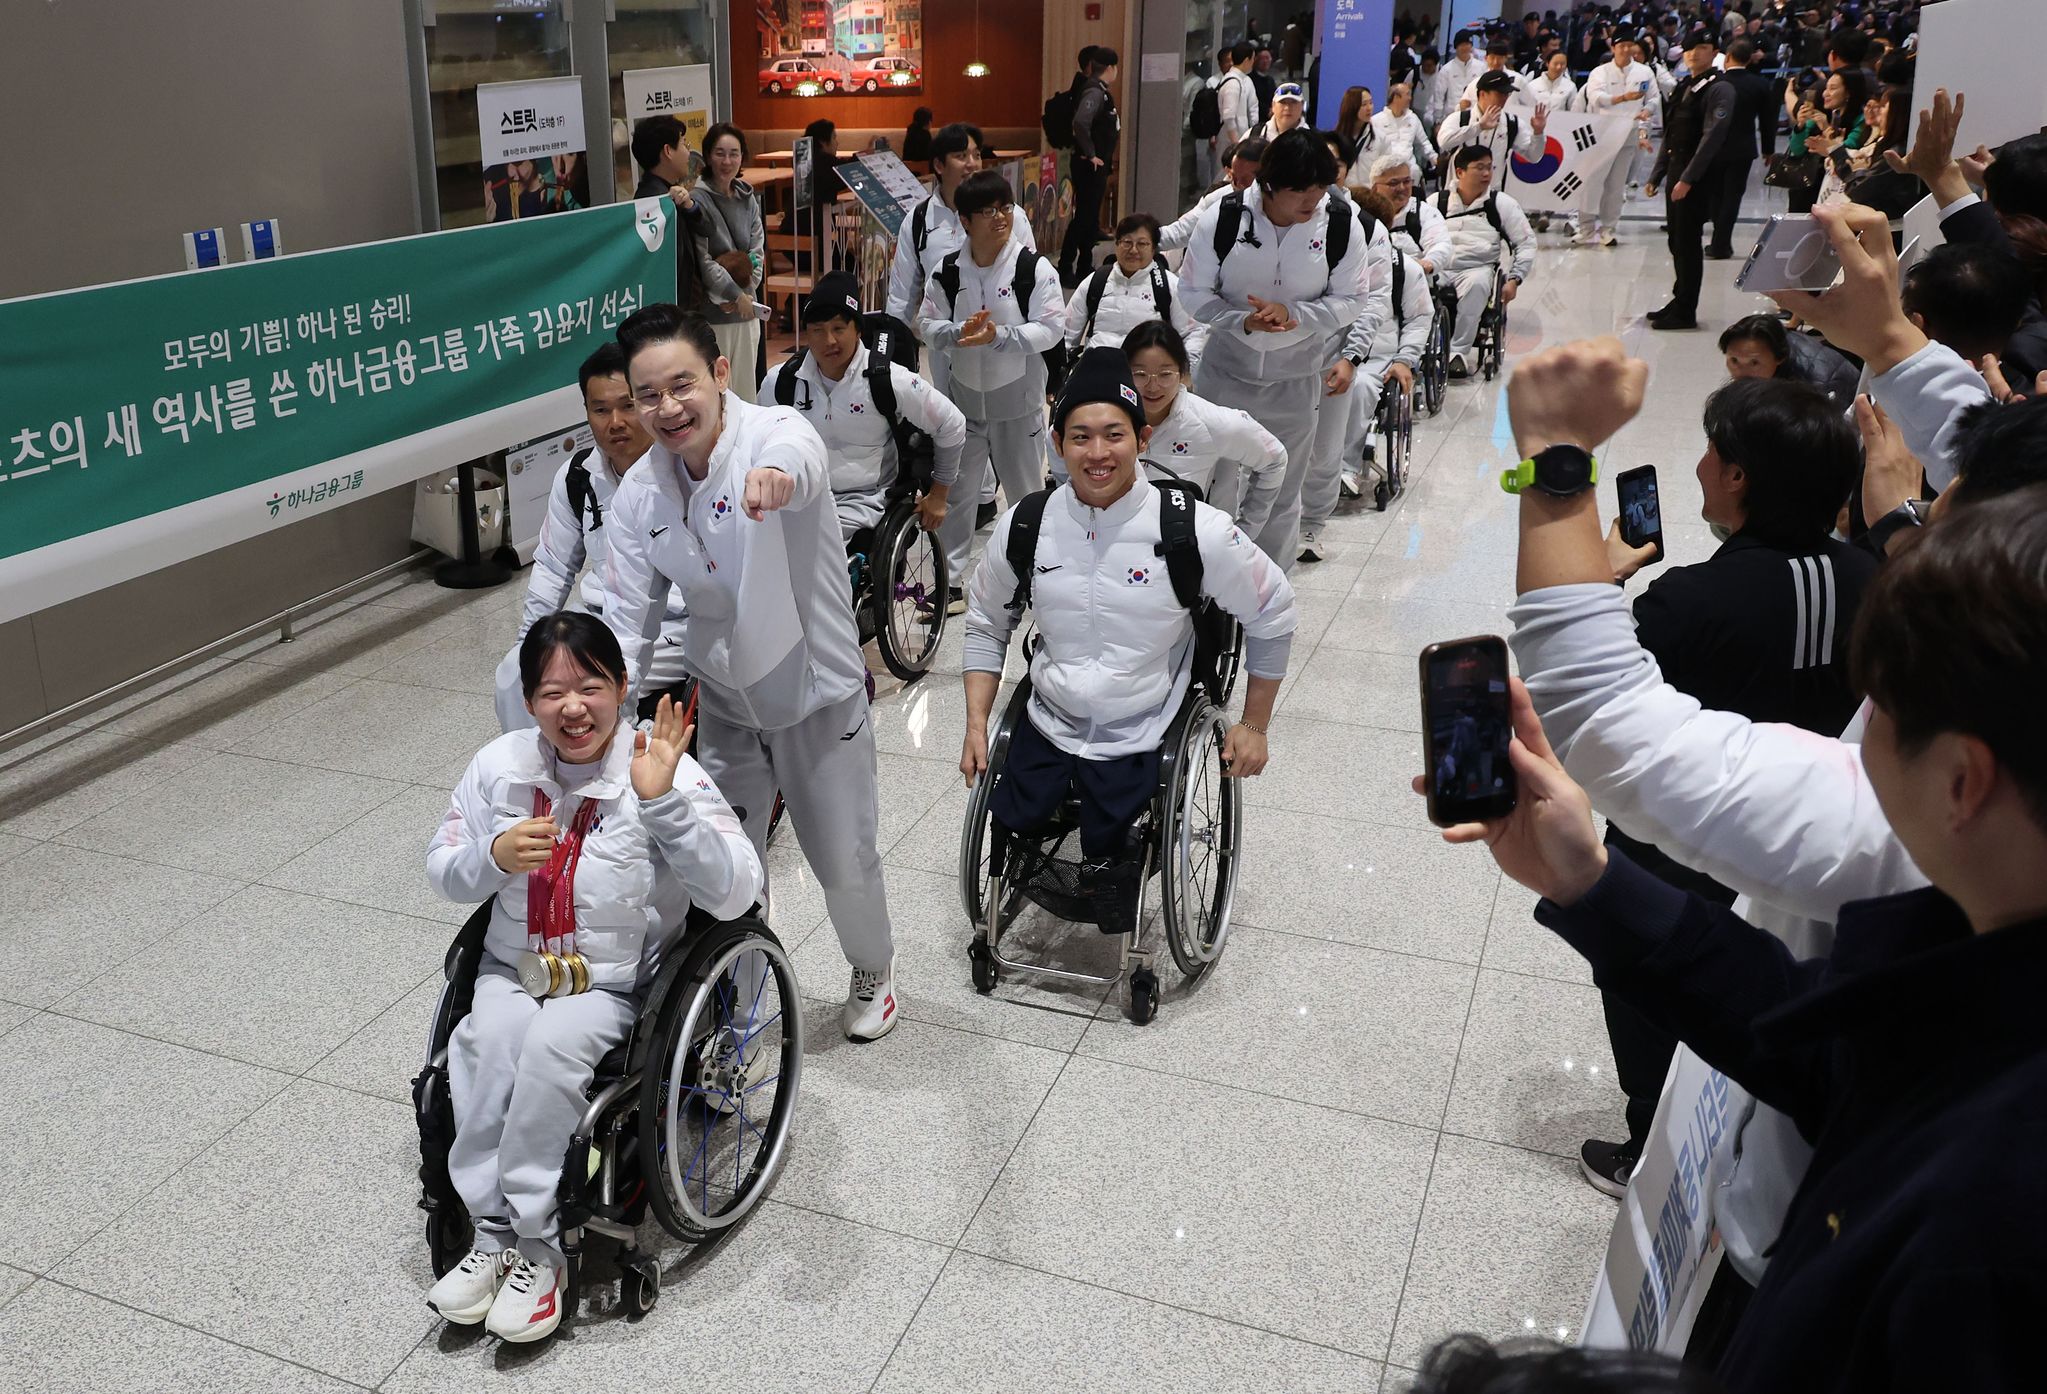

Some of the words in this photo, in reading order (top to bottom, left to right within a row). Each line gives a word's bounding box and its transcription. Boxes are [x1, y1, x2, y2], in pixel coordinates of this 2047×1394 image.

[1336, 12, 1364, 21] Arrivals
[646, 91, 672, 111] 스트릿
[501, 108, 538, 134] 스트릿
[539, 116, 556, 129] (도착층
[556, 115, 565, 128] 1F)
[164, 328, 232, 371] 모두의
[239, 317, 291, 356] 기쁨!
[296, 308, 338, 344] 하나
[343, 302, 362, 336] 된
[369, 293, 411, 331] 승리!
[0, 415, 88, 482] 츠의
[103, 403, 143, 457] 새
[152, 377, 257, 444] 역사를
[269, 369, 299, 418] 쓴
[306, 327, 469, 404] 하나금융그룹
[473, 315, 525, 361] 가족
[528, 296, 594, 350] 김윤지
[599, 284, 643, 330] 선수!
[287, 469, 364, 509] 하나금융그룹
